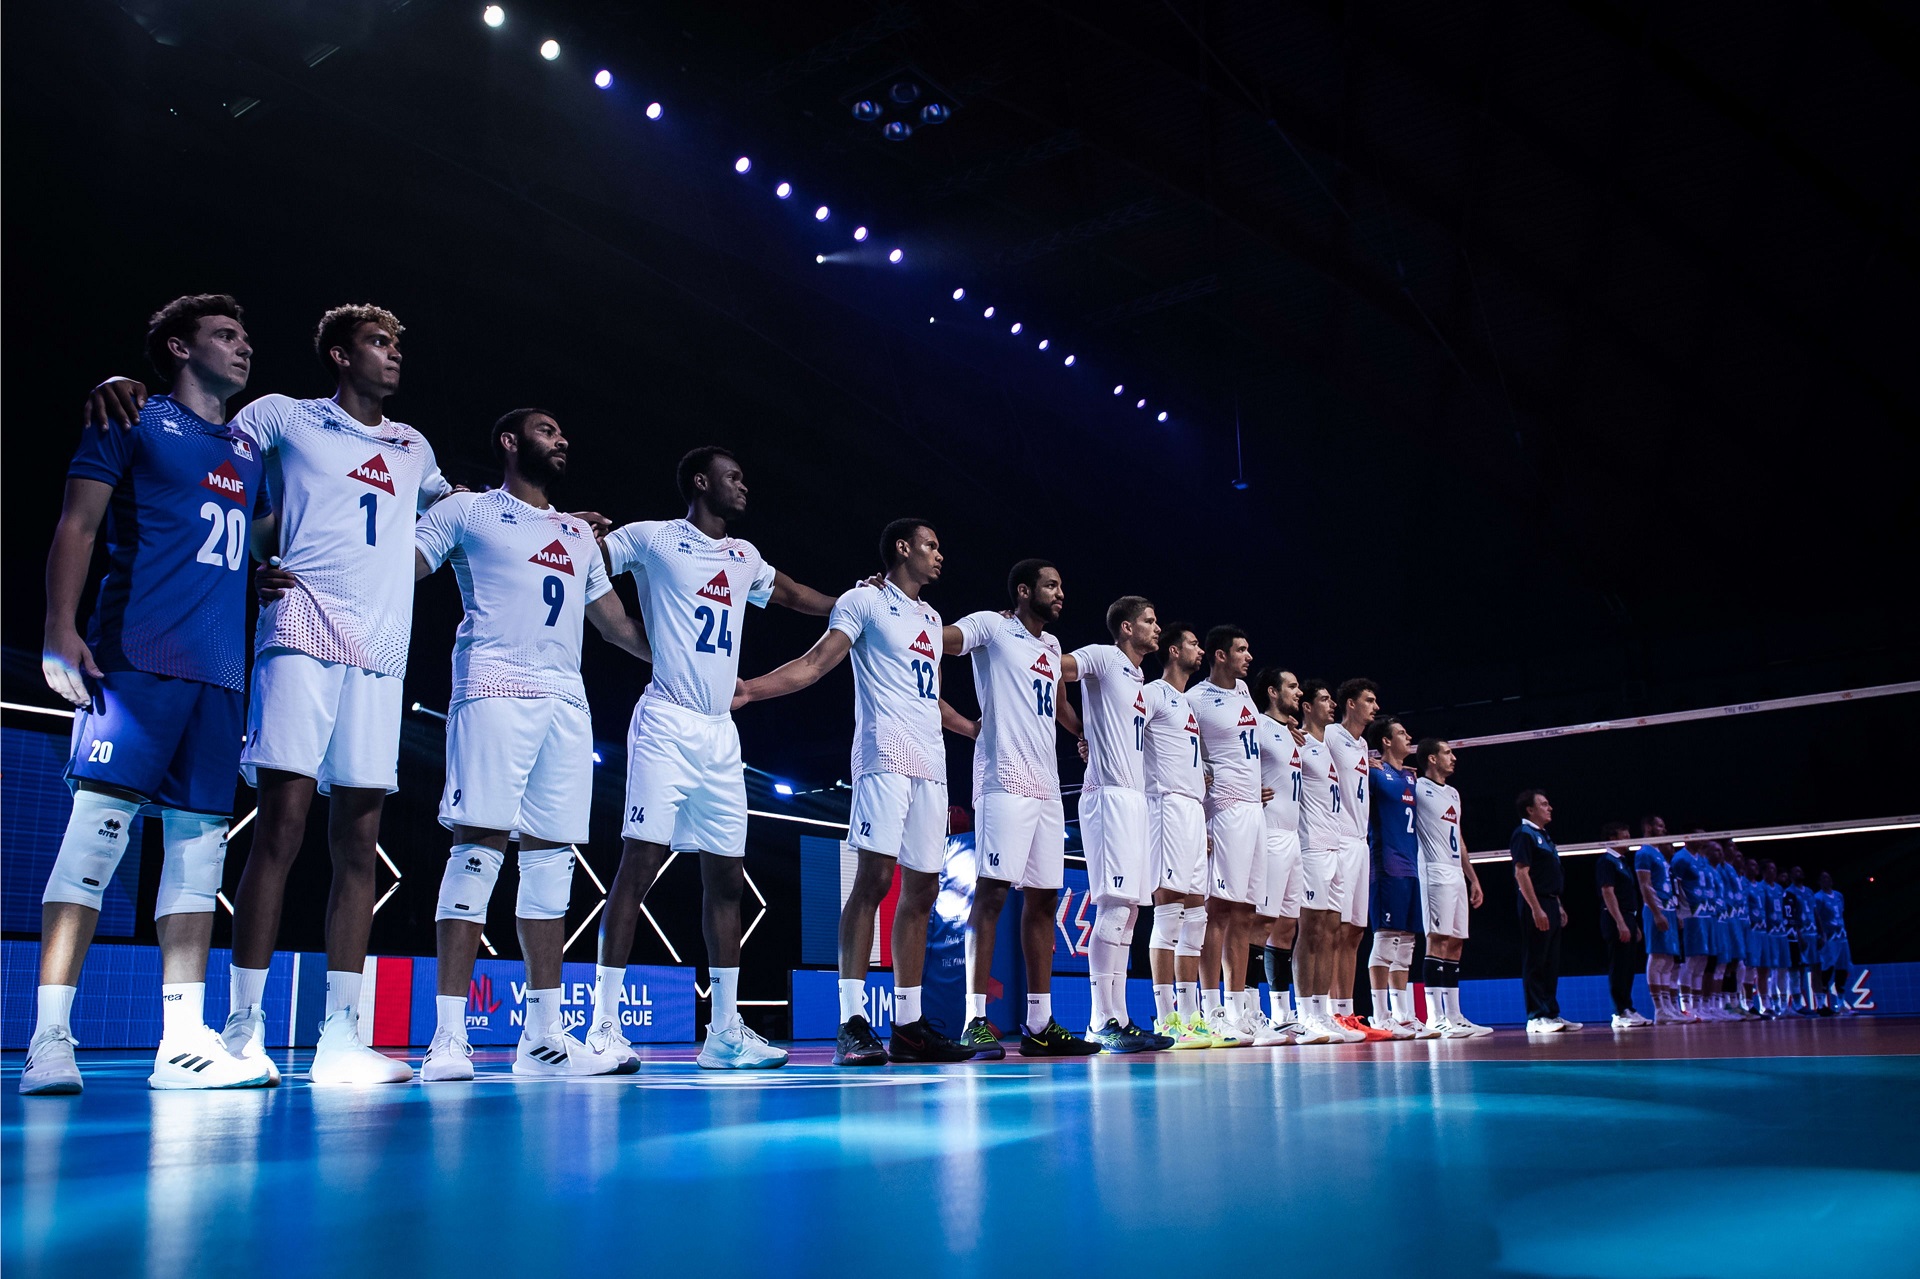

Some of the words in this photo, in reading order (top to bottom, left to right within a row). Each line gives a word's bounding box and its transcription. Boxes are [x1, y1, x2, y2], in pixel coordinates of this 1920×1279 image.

[207, 471, 244, 494] MAIF
[356, 466, 392, 483] MAIF
[359, 492, 378, 547] 1
[196, 501, 247, 571] 20
[537, 551, 571, 565] MAIF
[542, 575, 565, 627] 9
[703, 584, 731, 597] MAIF
[694, 605, 733, 658] 24
[913, 641, 933, 652] MAIF
[910, 659, 938, 701] 12
[1032, 678, 1054, 718] 16
[88, 739, 114, 764] 20
[1189, 735, 1198, 768] 7
[1238, 728, 1260, 760] 14
[1291, 770, 1302, 802] 11
[1356, 776, 1364, 803] 4
[451, 789, 462, 807] 9
[629, 805, 645, 824] 24
[1405, 806, 1415, 834] 2
[859, 821, 871, 838] 12
[1449, 826, 1458, 852] 6
[988, 852, 999, 867] 16
[1112, 875, 1124, 888] 17
[1166, 868, 1173, 880] 7
[1217, 879, 1226, 890] 14
[1305, 890, 1315, 901] 19
[1385, 912, 1391, 922] 2
